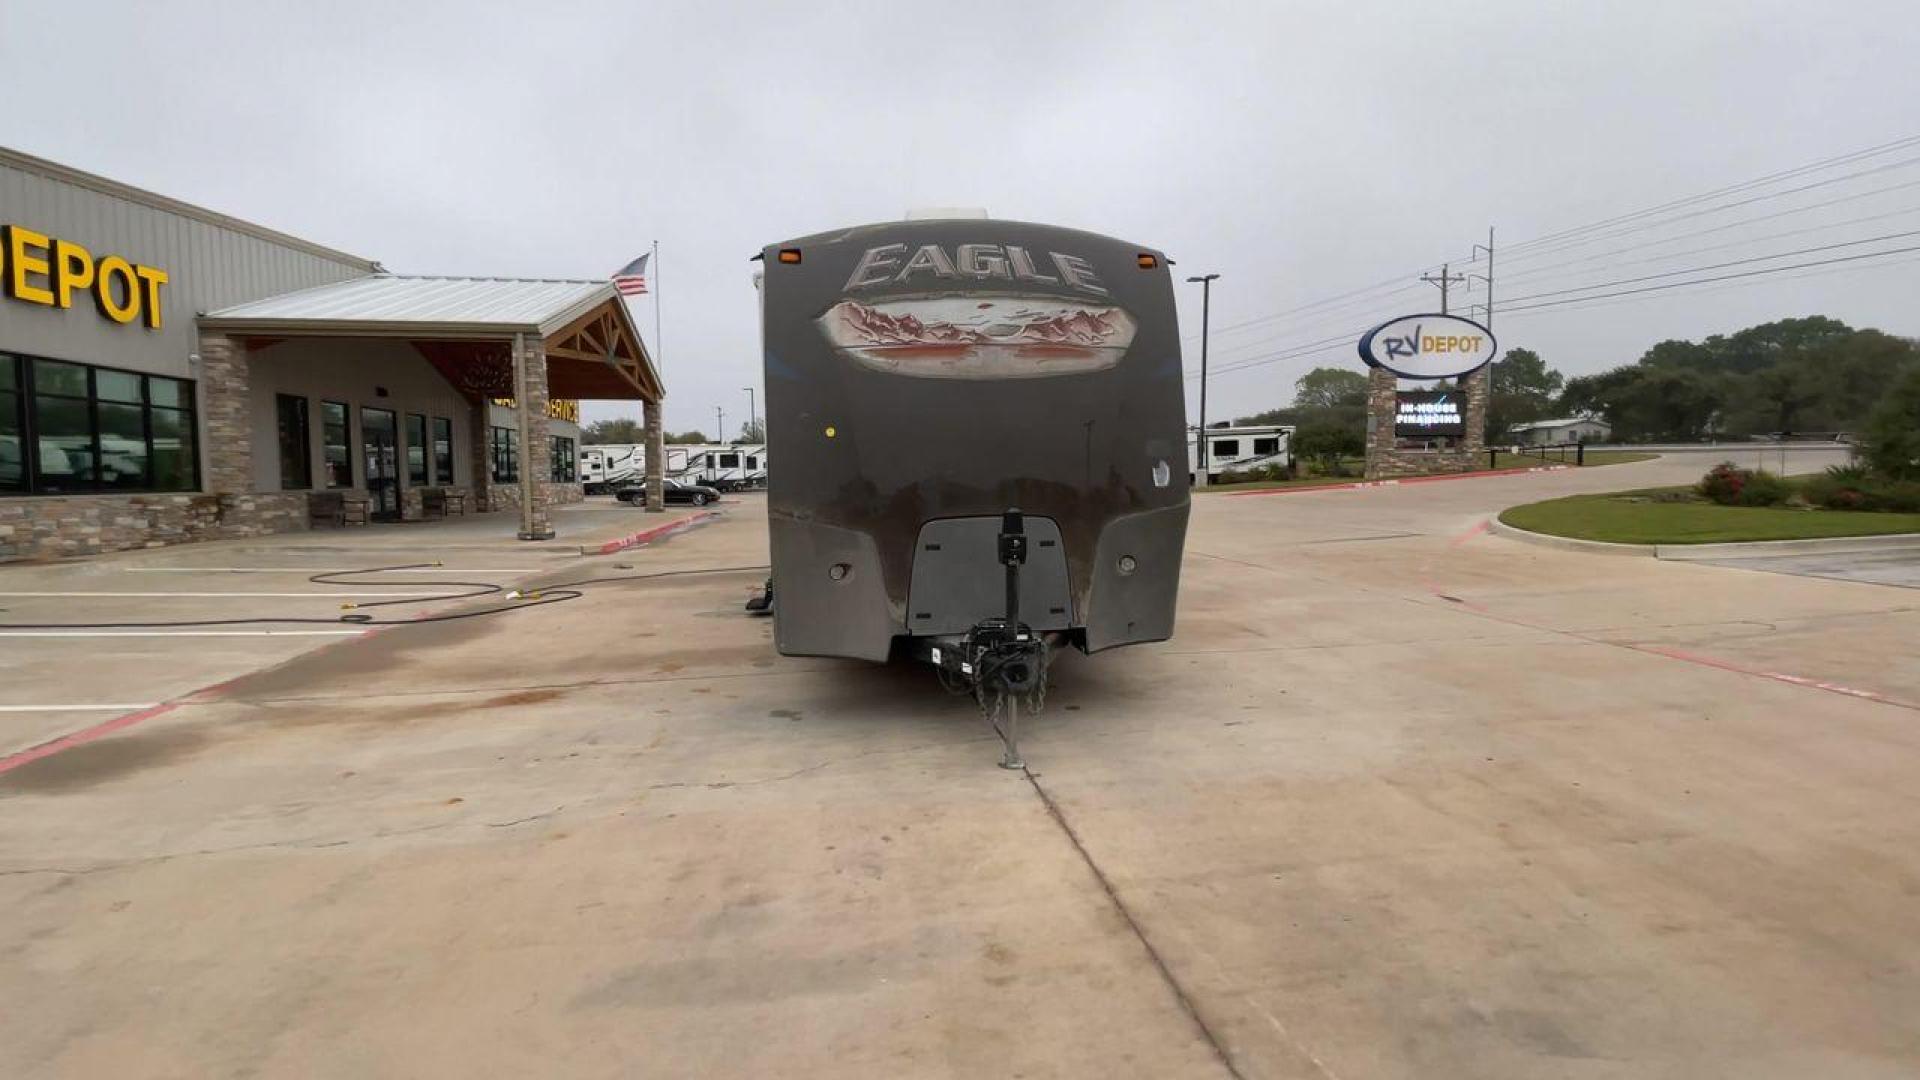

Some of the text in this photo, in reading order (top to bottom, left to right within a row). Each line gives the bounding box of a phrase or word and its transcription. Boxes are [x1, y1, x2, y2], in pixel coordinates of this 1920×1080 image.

[0, 224, 169, 329] EPOT
[842, 241, 1109, 296] EAGLE
[1383, 324, 1482, 360] RV DEPOT
